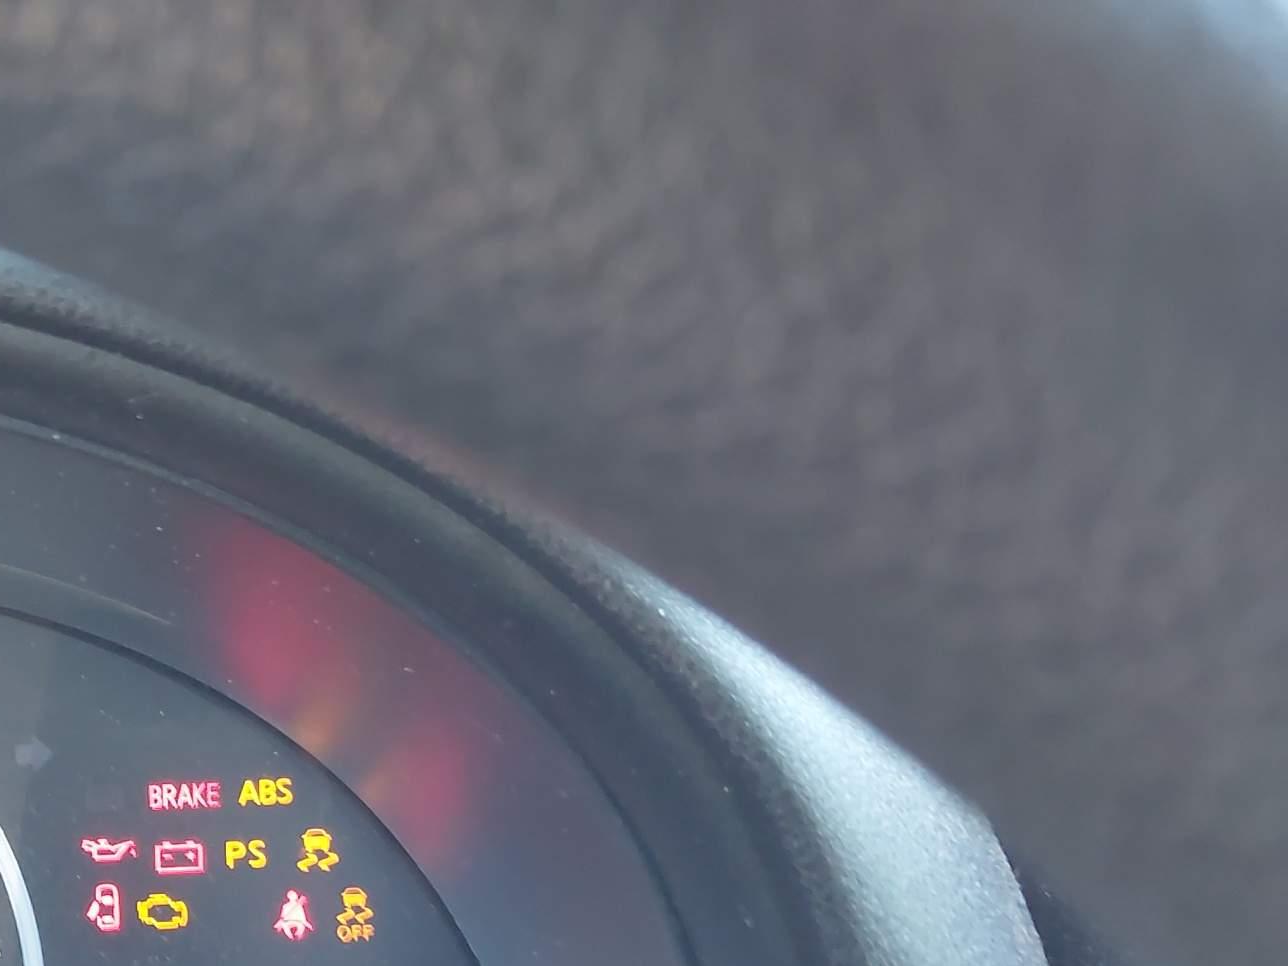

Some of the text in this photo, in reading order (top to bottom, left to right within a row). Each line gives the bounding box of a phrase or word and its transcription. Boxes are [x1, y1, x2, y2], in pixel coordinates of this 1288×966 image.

[148, 782, 221, 810] BRAKE
[238, 778, 293, 806] ABS
[224, 839, 268, 869] PS
[336, 925, 375, 943] OFF
